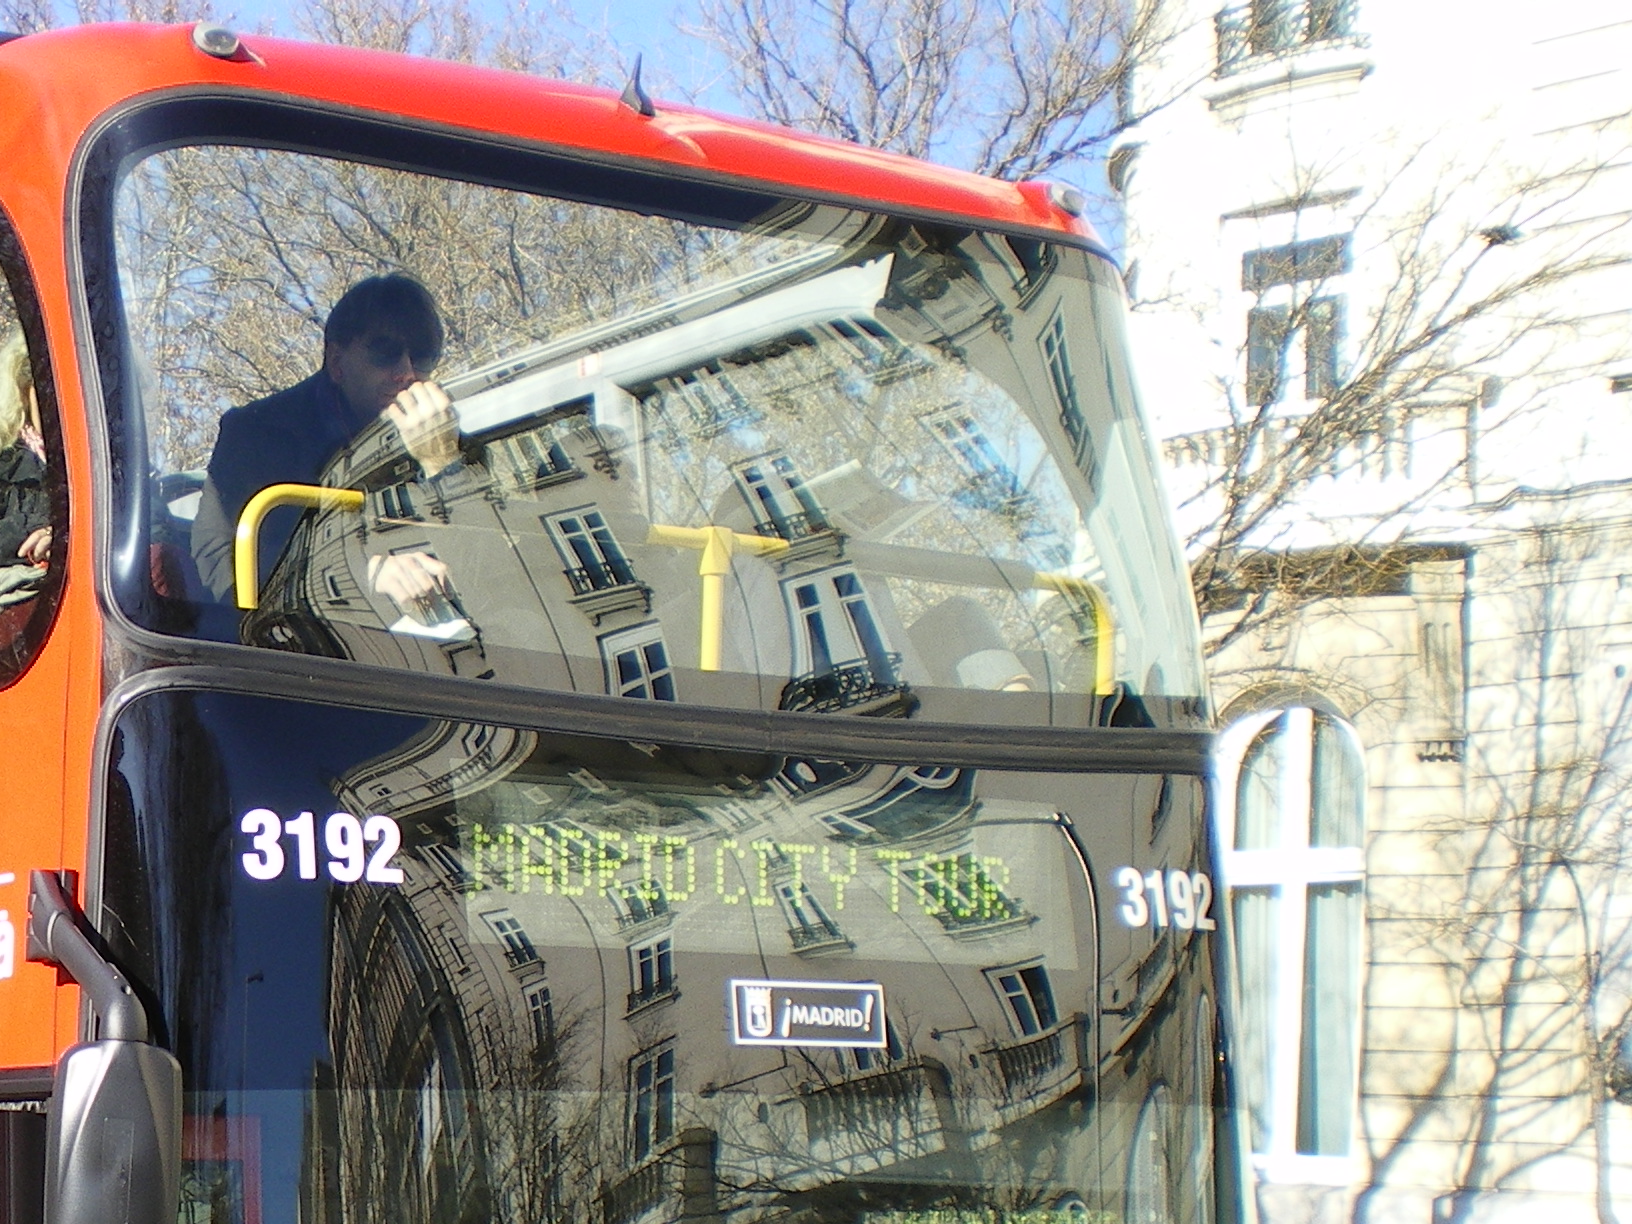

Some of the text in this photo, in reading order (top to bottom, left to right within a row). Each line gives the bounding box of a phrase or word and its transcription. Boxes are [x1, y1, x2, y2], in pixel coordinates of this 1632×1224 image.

[241, 808, 404, 883] 3192
[468, 823, 1012, 919] MADRID CITY TOUR
[1117, 867, 1216, 931] 3192
